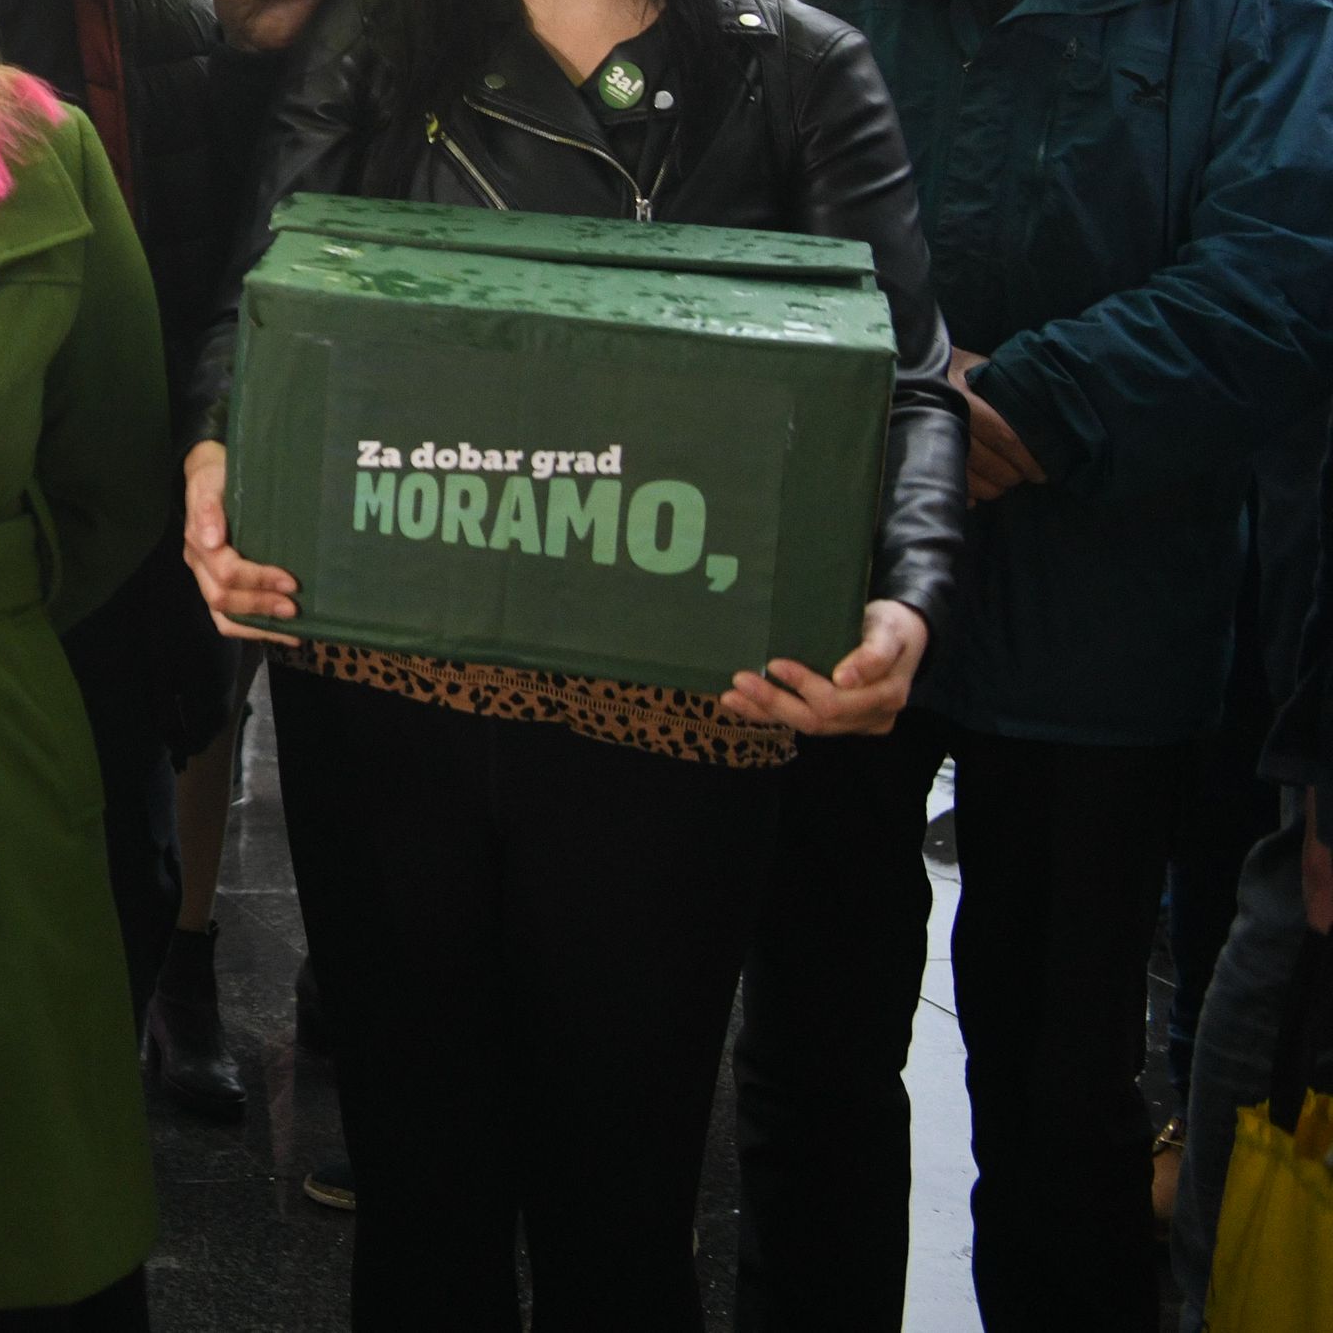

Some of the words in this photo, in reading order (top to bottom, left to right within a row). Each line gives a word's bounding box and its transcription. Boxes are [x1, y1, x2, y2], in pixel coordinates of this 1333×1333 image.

[356, 440, 403, 469] Za
[409, 441, 524, 472] dobar
[530, 444, 623, 480] grad
[353, 471, 739, 593] MORAMO,
